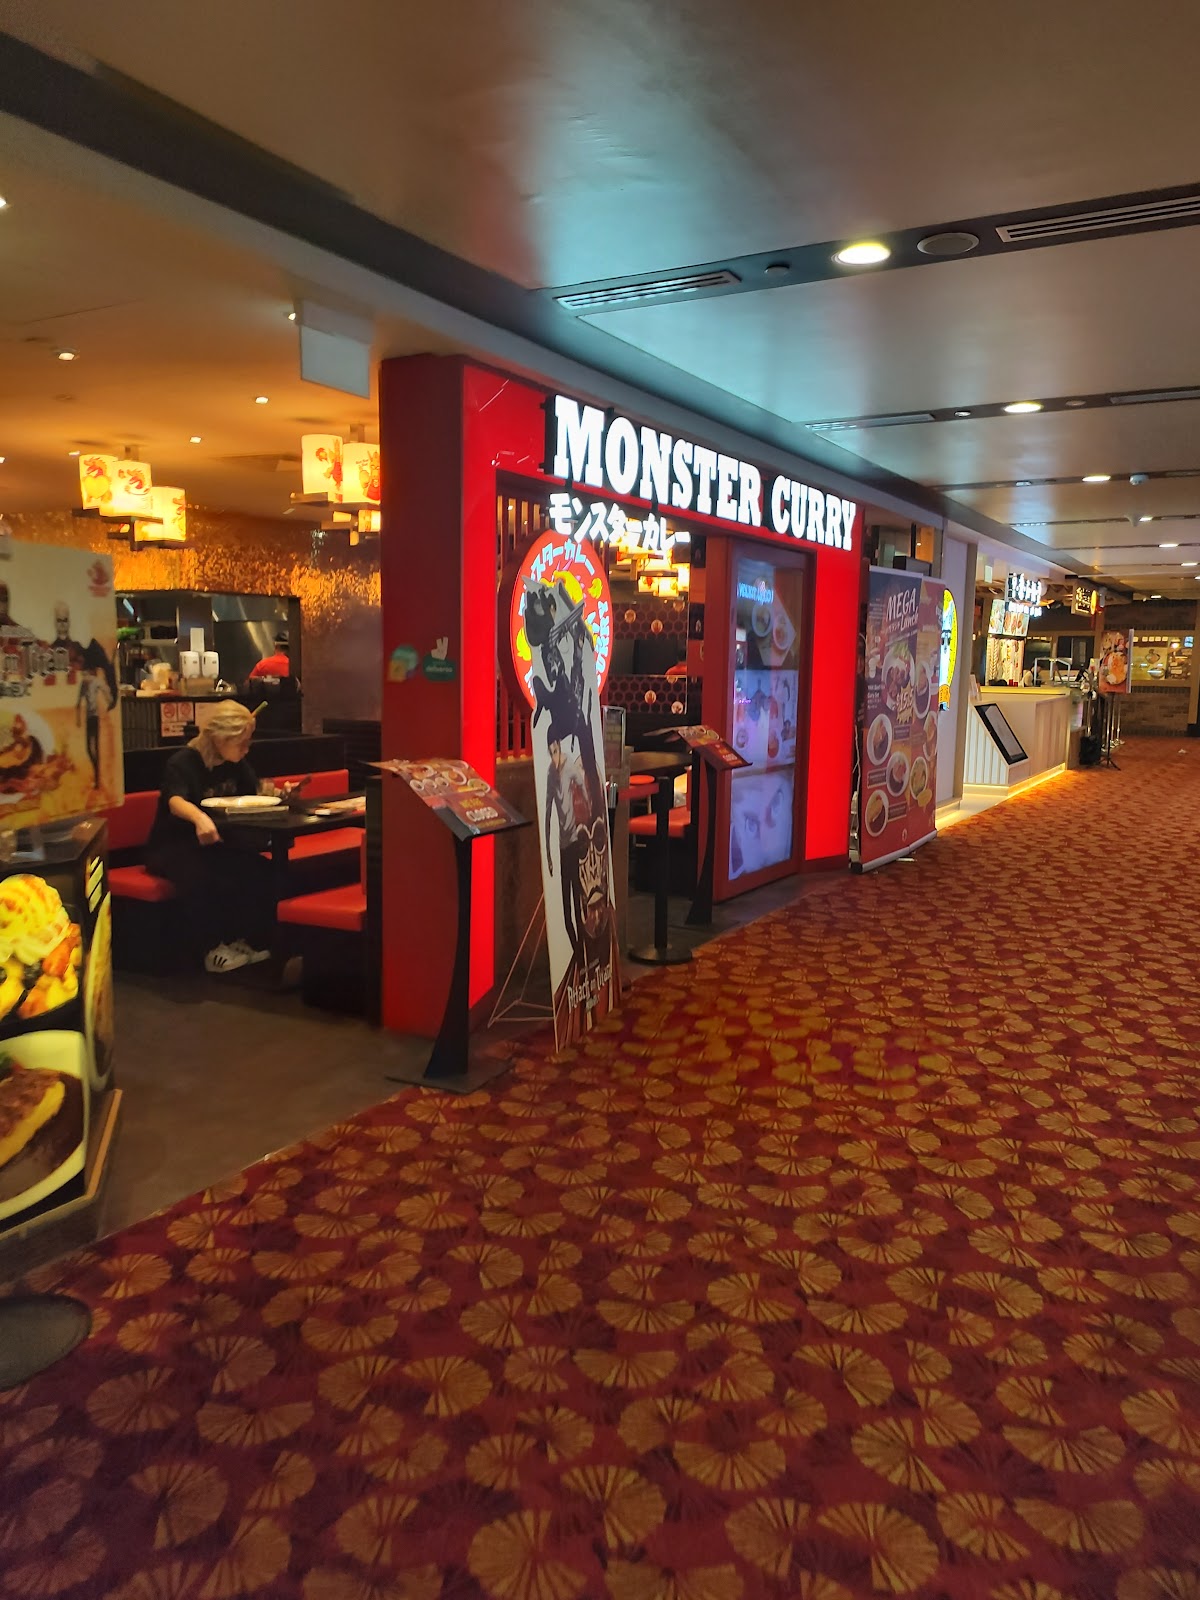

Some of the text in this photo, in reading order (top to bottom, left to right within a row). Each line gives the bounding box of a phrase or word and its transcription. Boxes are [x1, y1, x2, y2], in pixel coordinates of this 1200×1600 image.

[553, 394, 857, 552] MONSTER CURRY
[548, 492, 691, 552] モンスターカレー
[885, 587, 917, 622] MEGA
[900, 605, 919, 631] Lunch
[567, 975, 591, 1015] Attack
